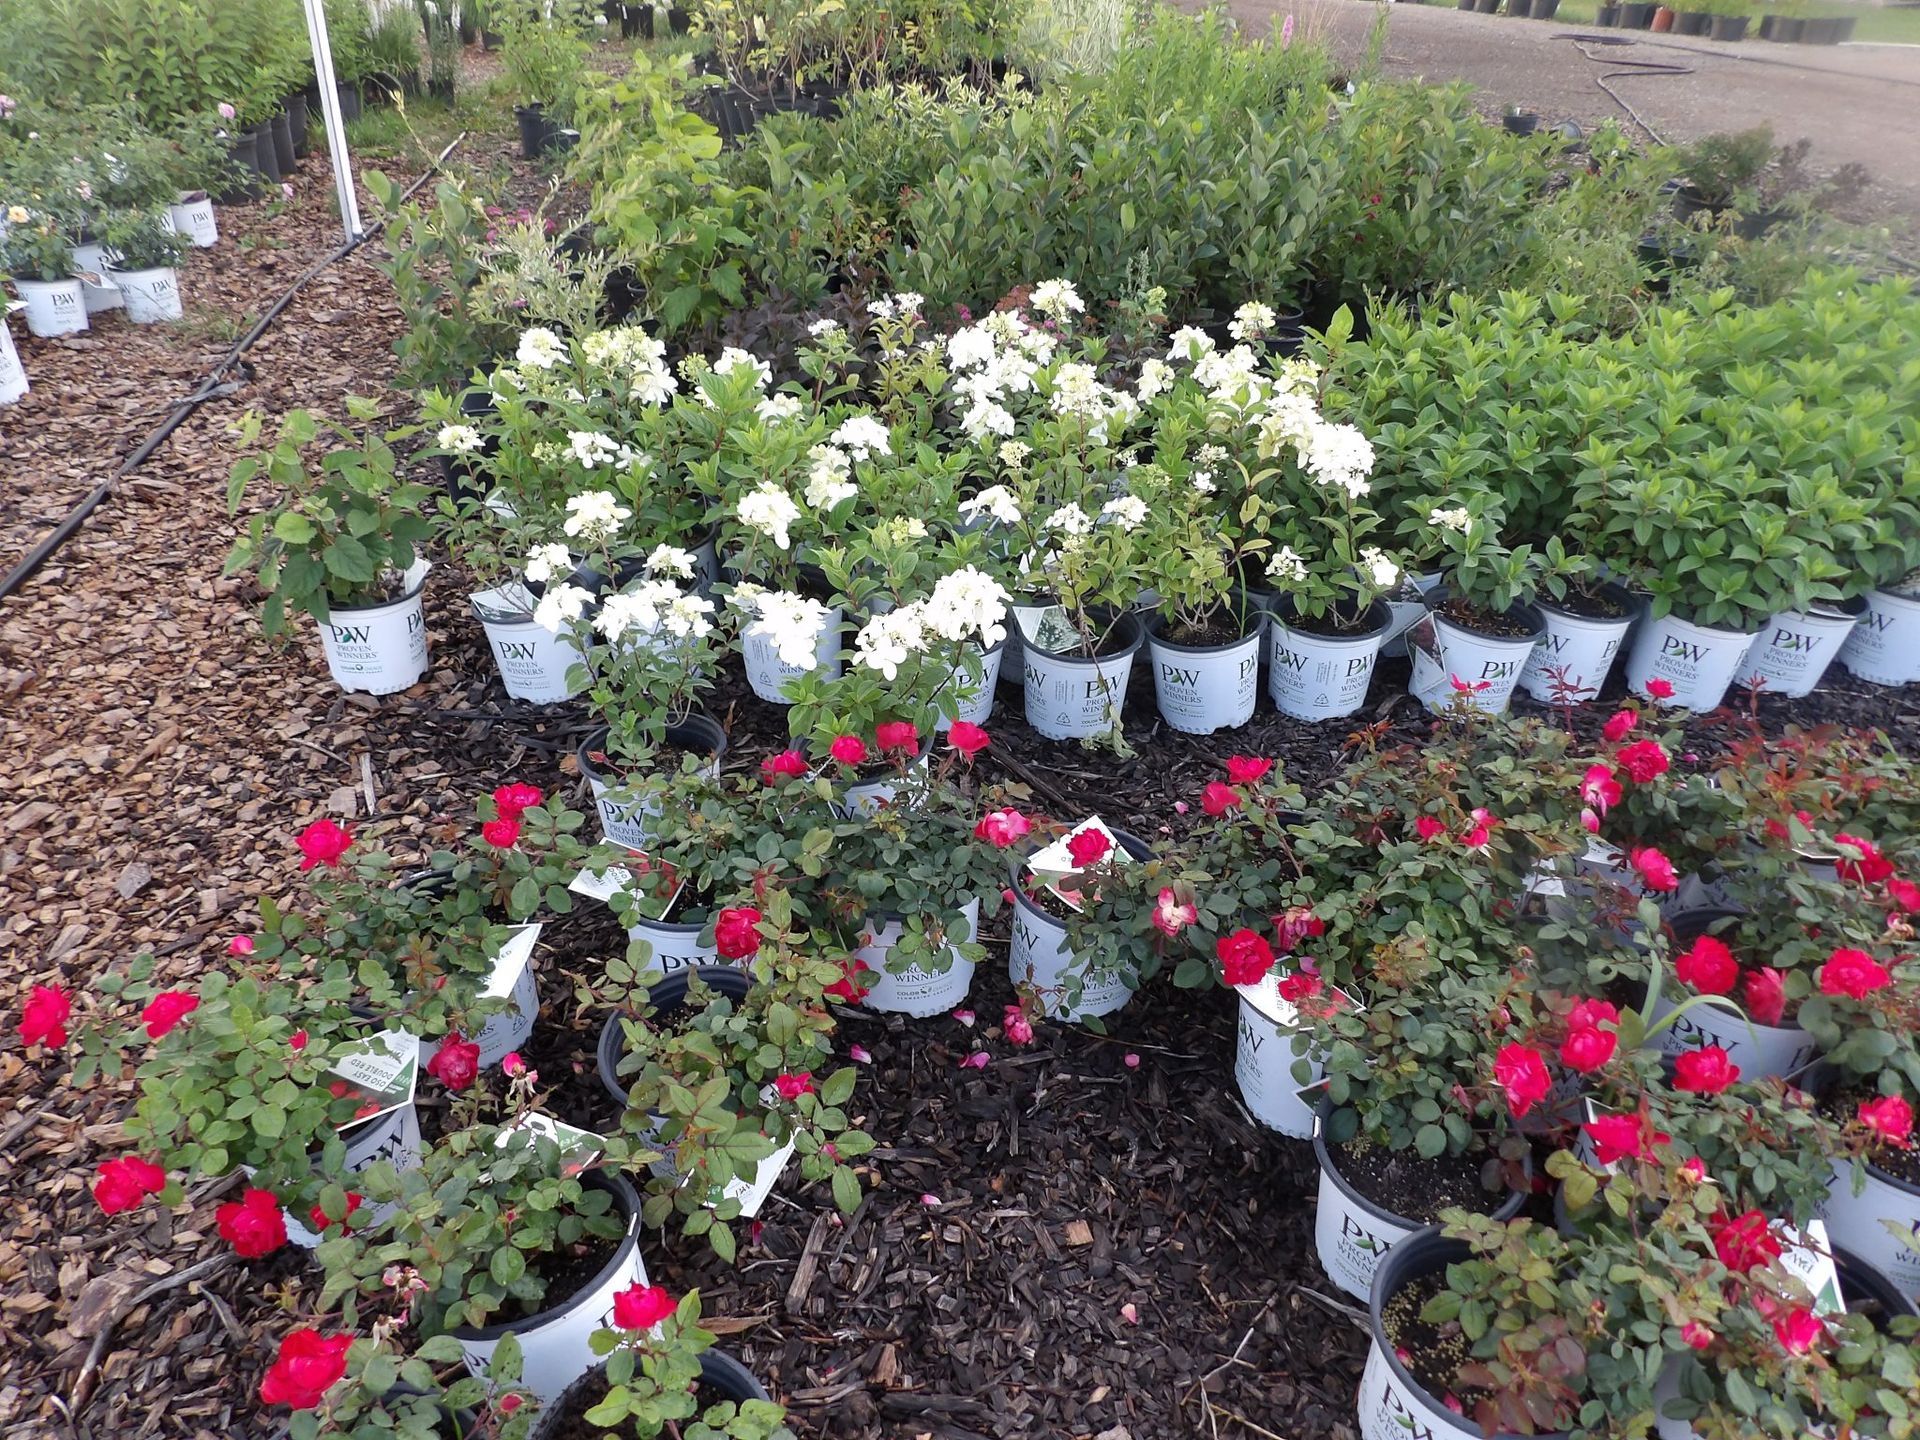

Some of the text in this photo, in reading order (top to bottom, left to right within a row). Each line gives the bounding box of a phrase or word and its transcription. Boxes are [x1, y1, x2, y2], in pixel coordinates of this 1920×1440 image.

[52, 293, 75, 306] PW
[331, 624, 370, 643] PW
[1770, 628, 1823, 653] PW
[336, 651, 378, 660] WINNERS
[498, 640, 537, 660] PW
[1275, 641, 1309, 672] PW
[1660, 634, 1711, 663] PW
[1769, 647, 1808, 661] PROVEN
[505, 660, 538, 668] PROVEN
[1344, 653, 1374, 678] PW
[1479, 659, 1521, 679] PW
[1660, 654, 1697, 672] PROVEN
[1763, 652, 1809, 668] WINNERS
[506, 667, 545, 675] WINNERS
[779, 666, 805, 674] WINN
[1160, 662, 1202, 688] PW
[1274, 662, 1302, 681] PROVEN
[1654, 659, 1698, 680] WINNERS
[1084, 672, 1123, 699] PW
[1274, 668, 1306, 690] WINNERS
[1163, 689, 1203, 704] WINNERS
[1164, 682, 1198, 696] PROVEN
[602, 800, 646, 828] PW
[608, 823, 646, 837] PROVEN
[608, 829, 645, 846] WINNER
[352, 1070, 372, 1082] EASY
[365, 1064, 394, 1080] DOUBLE
[370, 1077, 387, 1088] OSO
[1336, 1239, 1373, 1274] WINN
[1341, 1237, 1376, 1266] PROV
